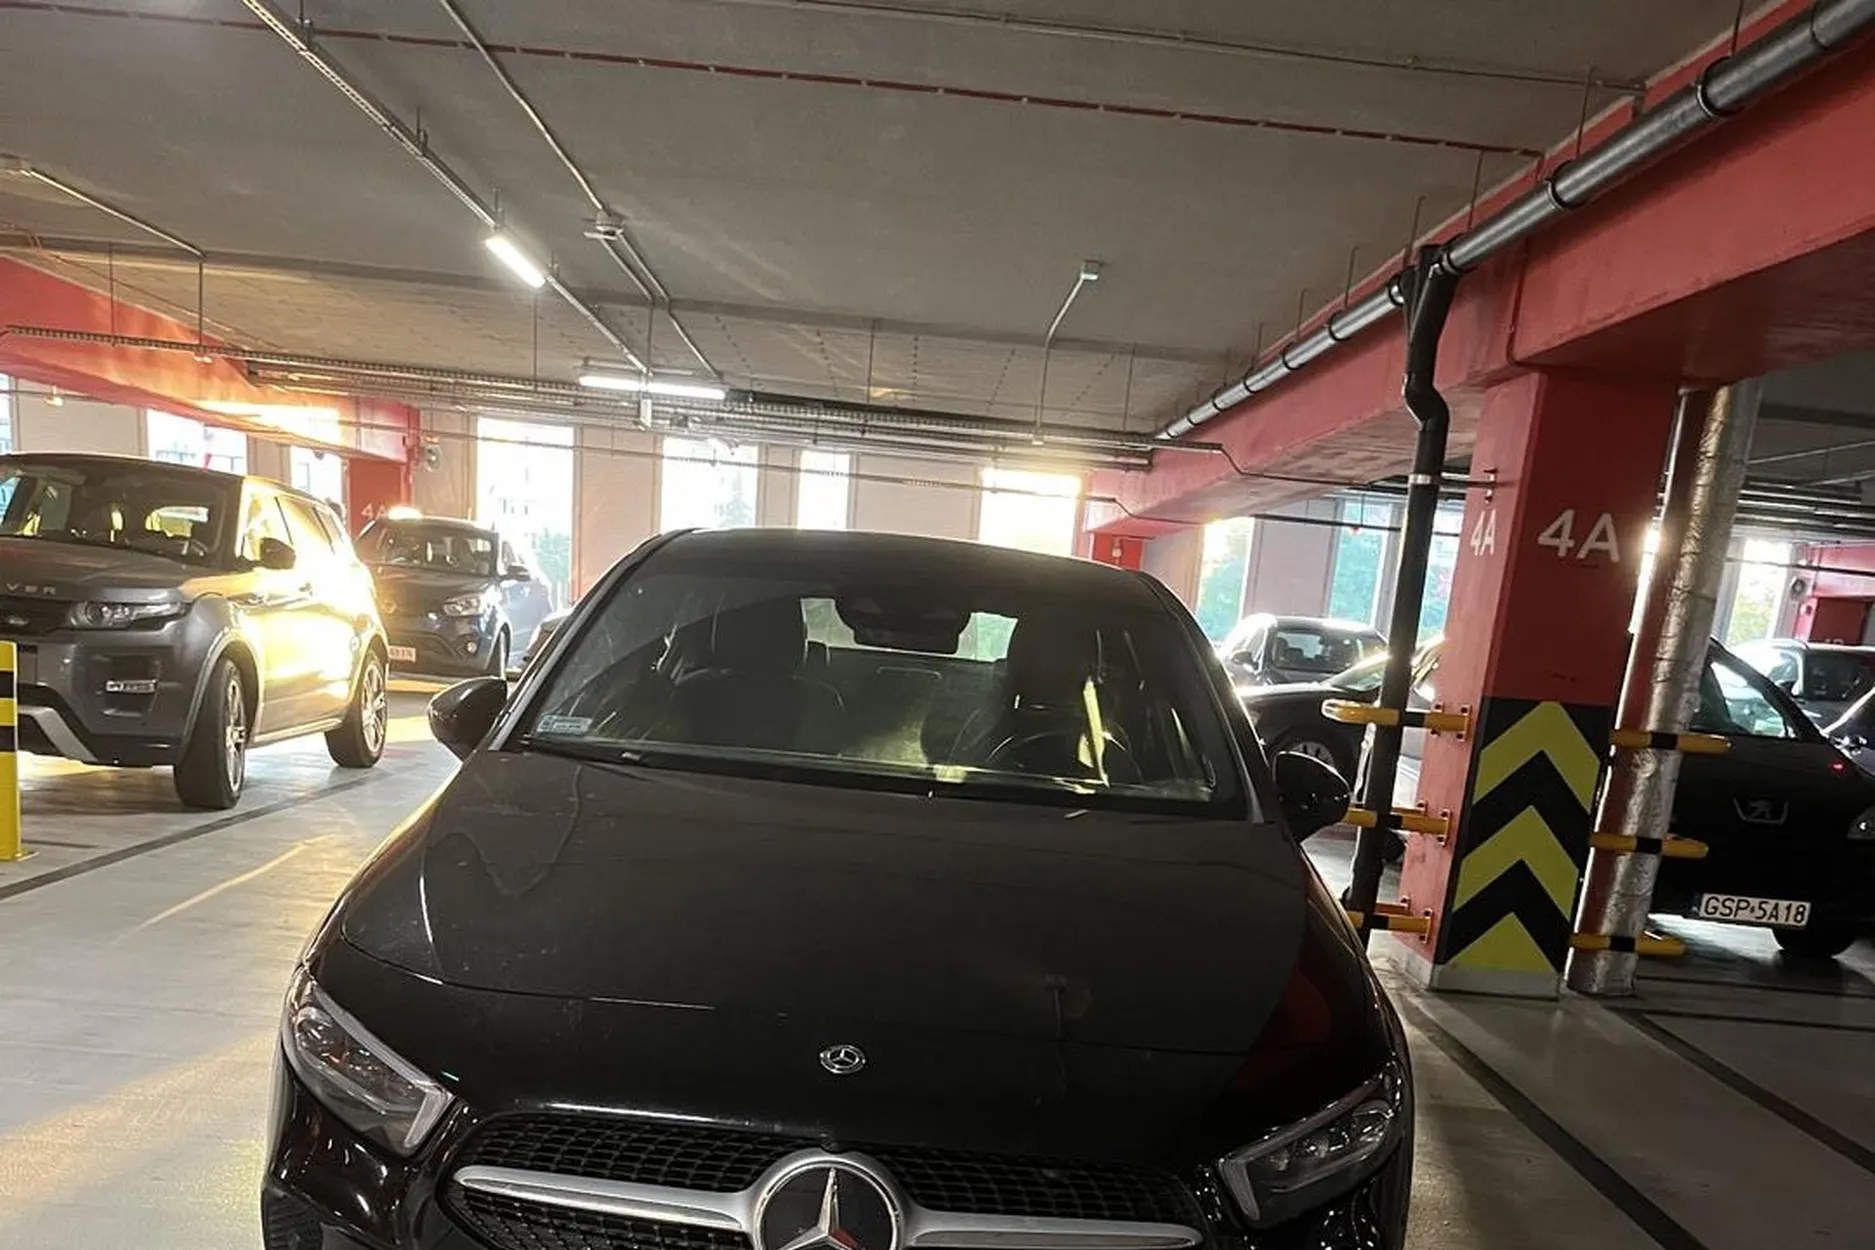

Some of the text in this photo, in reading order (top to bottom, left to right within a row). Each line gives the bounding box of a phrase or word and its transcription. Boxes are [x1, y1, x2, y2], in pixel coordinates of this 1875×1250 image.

[1470, 509, 1497, 556] 4A
[1537, 508, 1621, 563] 4A
[1704, 896, 1806, 923] GSP 5A18
